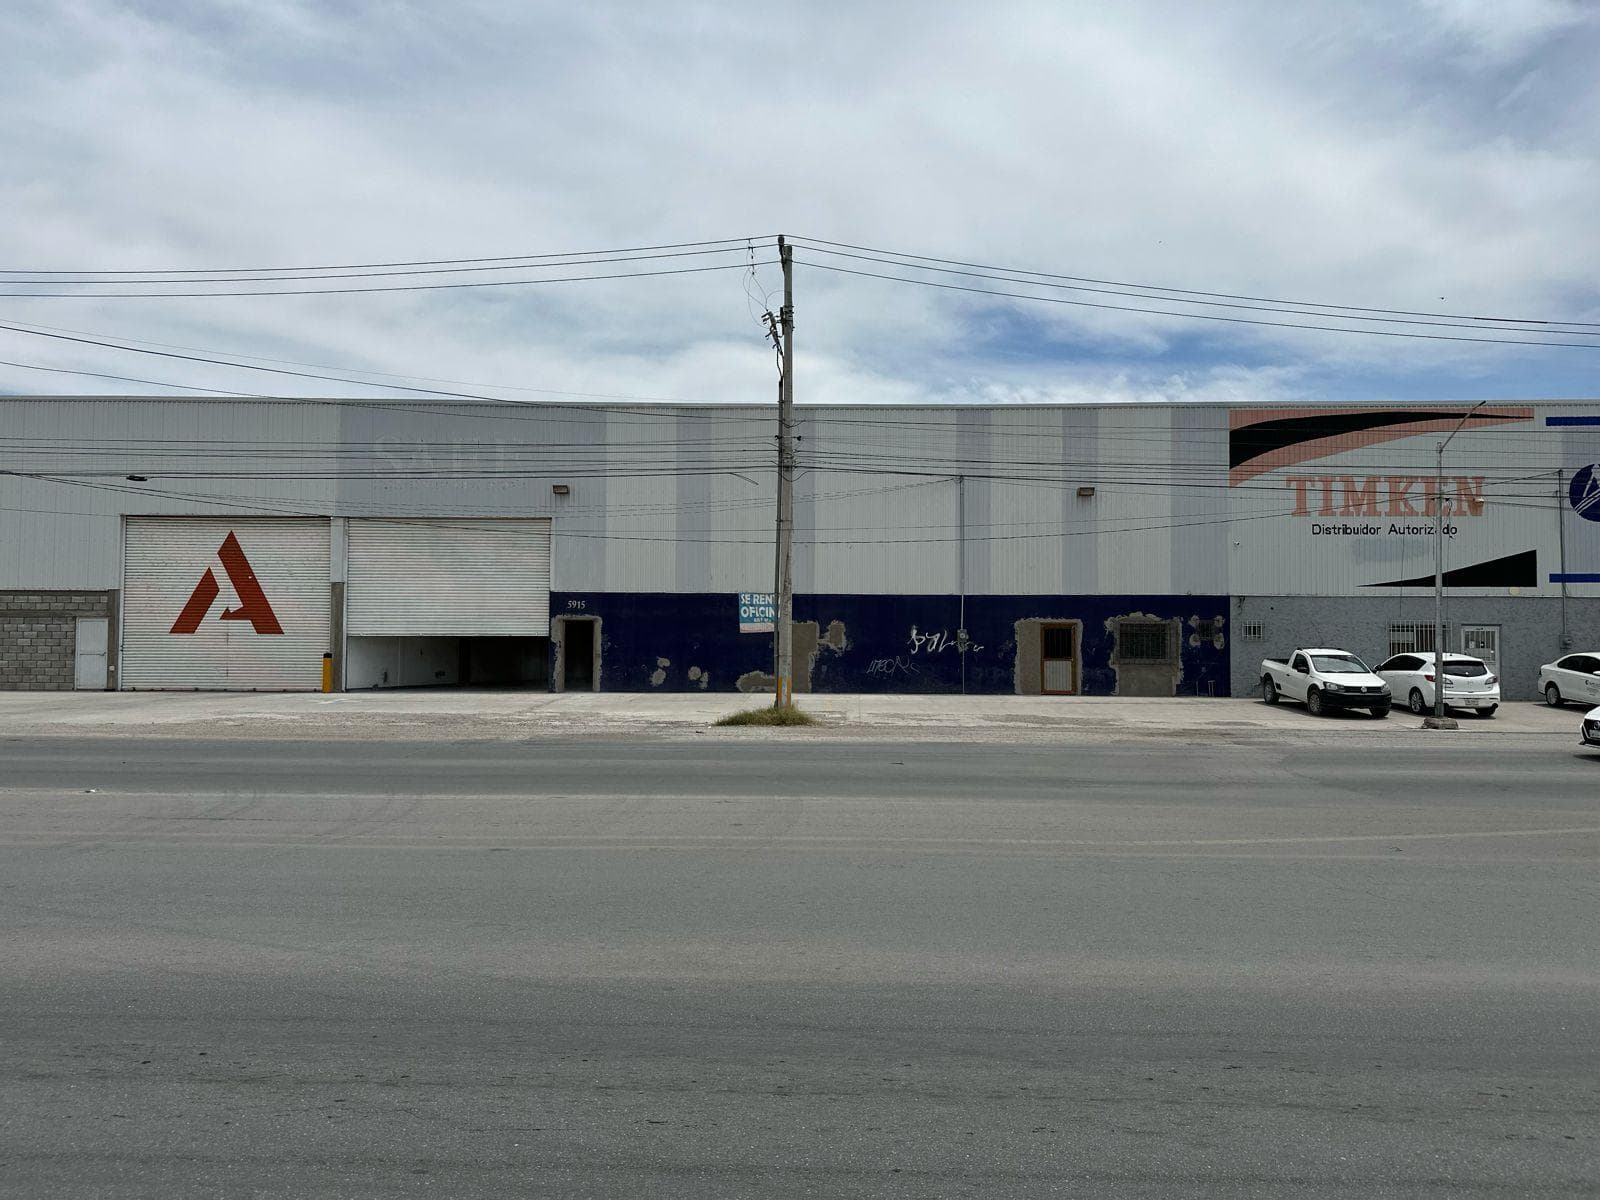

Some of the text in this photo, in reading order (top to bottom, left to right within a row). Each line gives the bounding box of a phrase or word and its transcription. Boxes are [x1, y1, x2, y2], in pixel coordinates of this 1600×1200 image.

[1286, 476, 1485, 517] TIMKEN
[1312, 523, 1382, 535] Distribuidor
[1388, 523, 1458, 535] Autorizdo
[567, 600, 586, 609] 5915
[741, 593, 776, 605] SE REN
[740, 606, 775, 618] OFICIN
